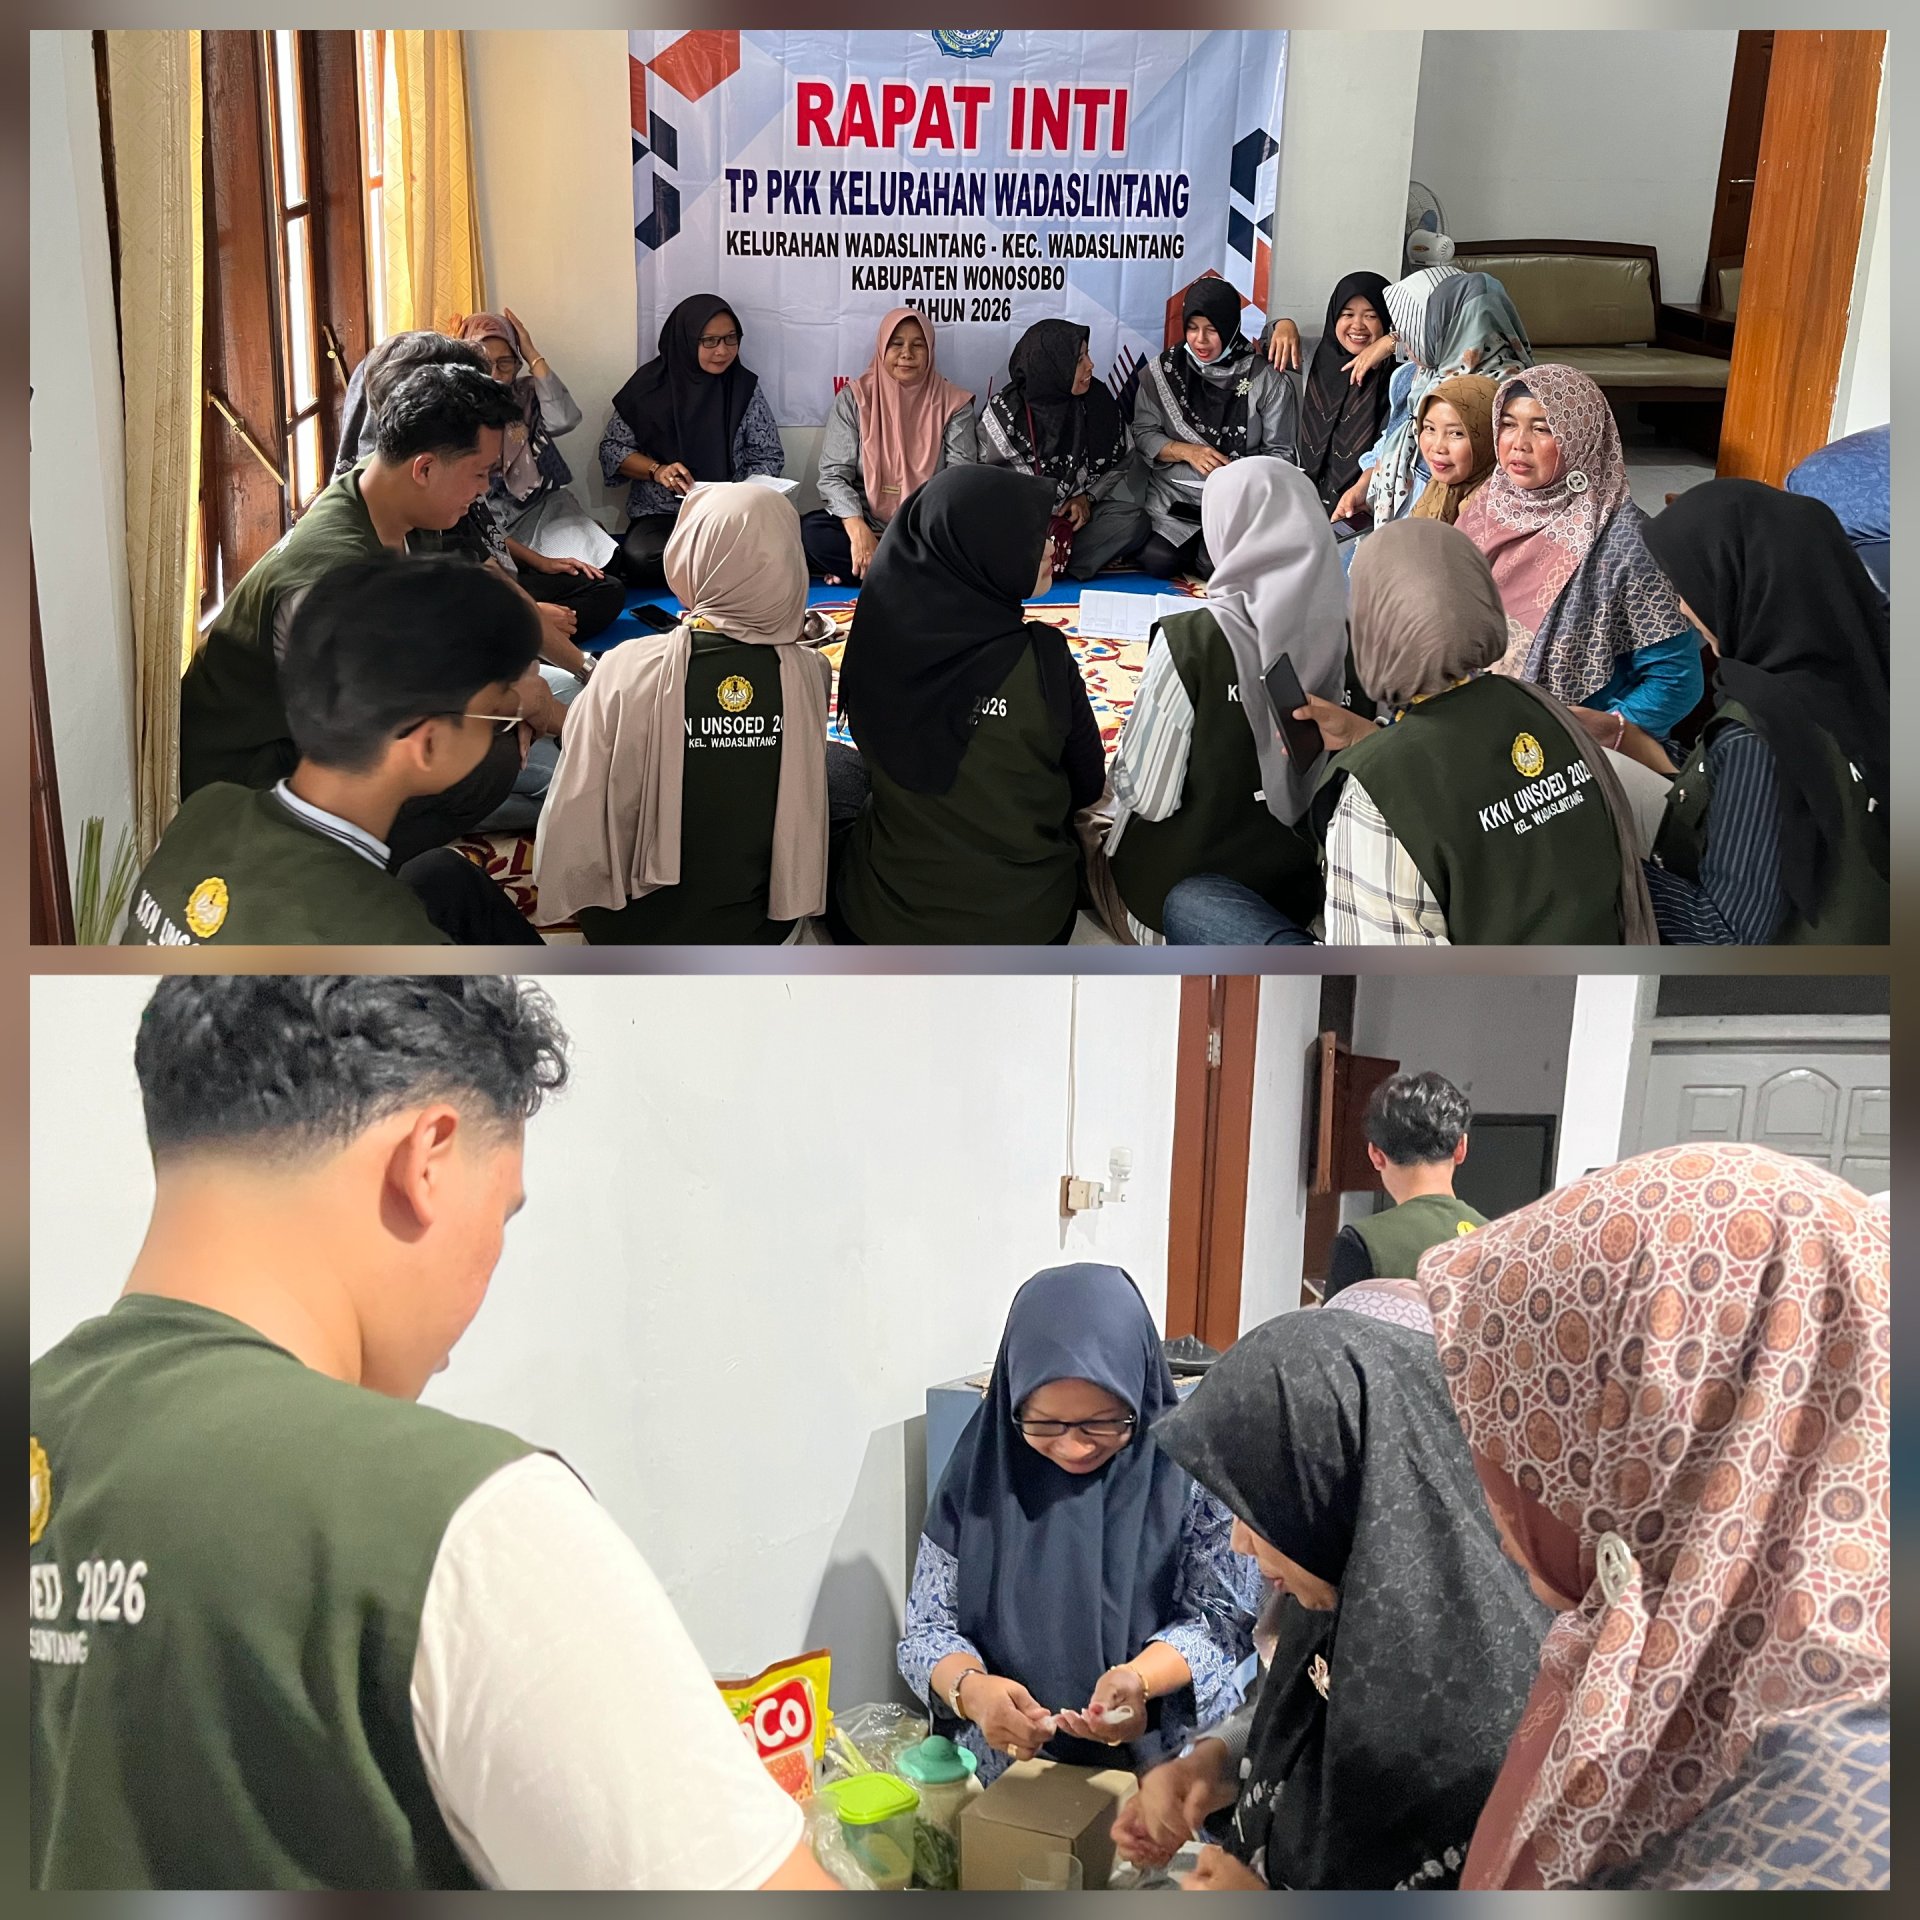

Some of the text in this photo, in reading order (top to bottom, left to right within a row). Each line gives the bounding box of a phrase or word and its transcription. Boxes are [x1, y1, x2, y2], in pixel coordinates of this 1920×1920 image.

[797, 82, 1128, 151] RAPAT INTI
[725, 168, 1190, 219] TP PKK KELURAHAN WADASLINTANG
[726, 230, 839, 258] KELURAHAN
[845, 232, 986, 258] WADASLINTANG
[1002, 233, 1042, 259] KEC.
[1048, 233, 1184, 259] WADASLINTANG
[851, 265, 1065, 291] KABUPATEN WONOSOBO
[971, 298, 1011, 322] 2026
[701, 716, 765, 735] UNSOED
[689, 736, 777, 748] KEL. WADASLINTANG
[1478, 798, 1514, 832] KKN
[1513, 772, 1567, 814] UNSOED
[1531, 790, 1585, 826] WADASLINTANG
[76, 1559, 148, 1624] 2026
